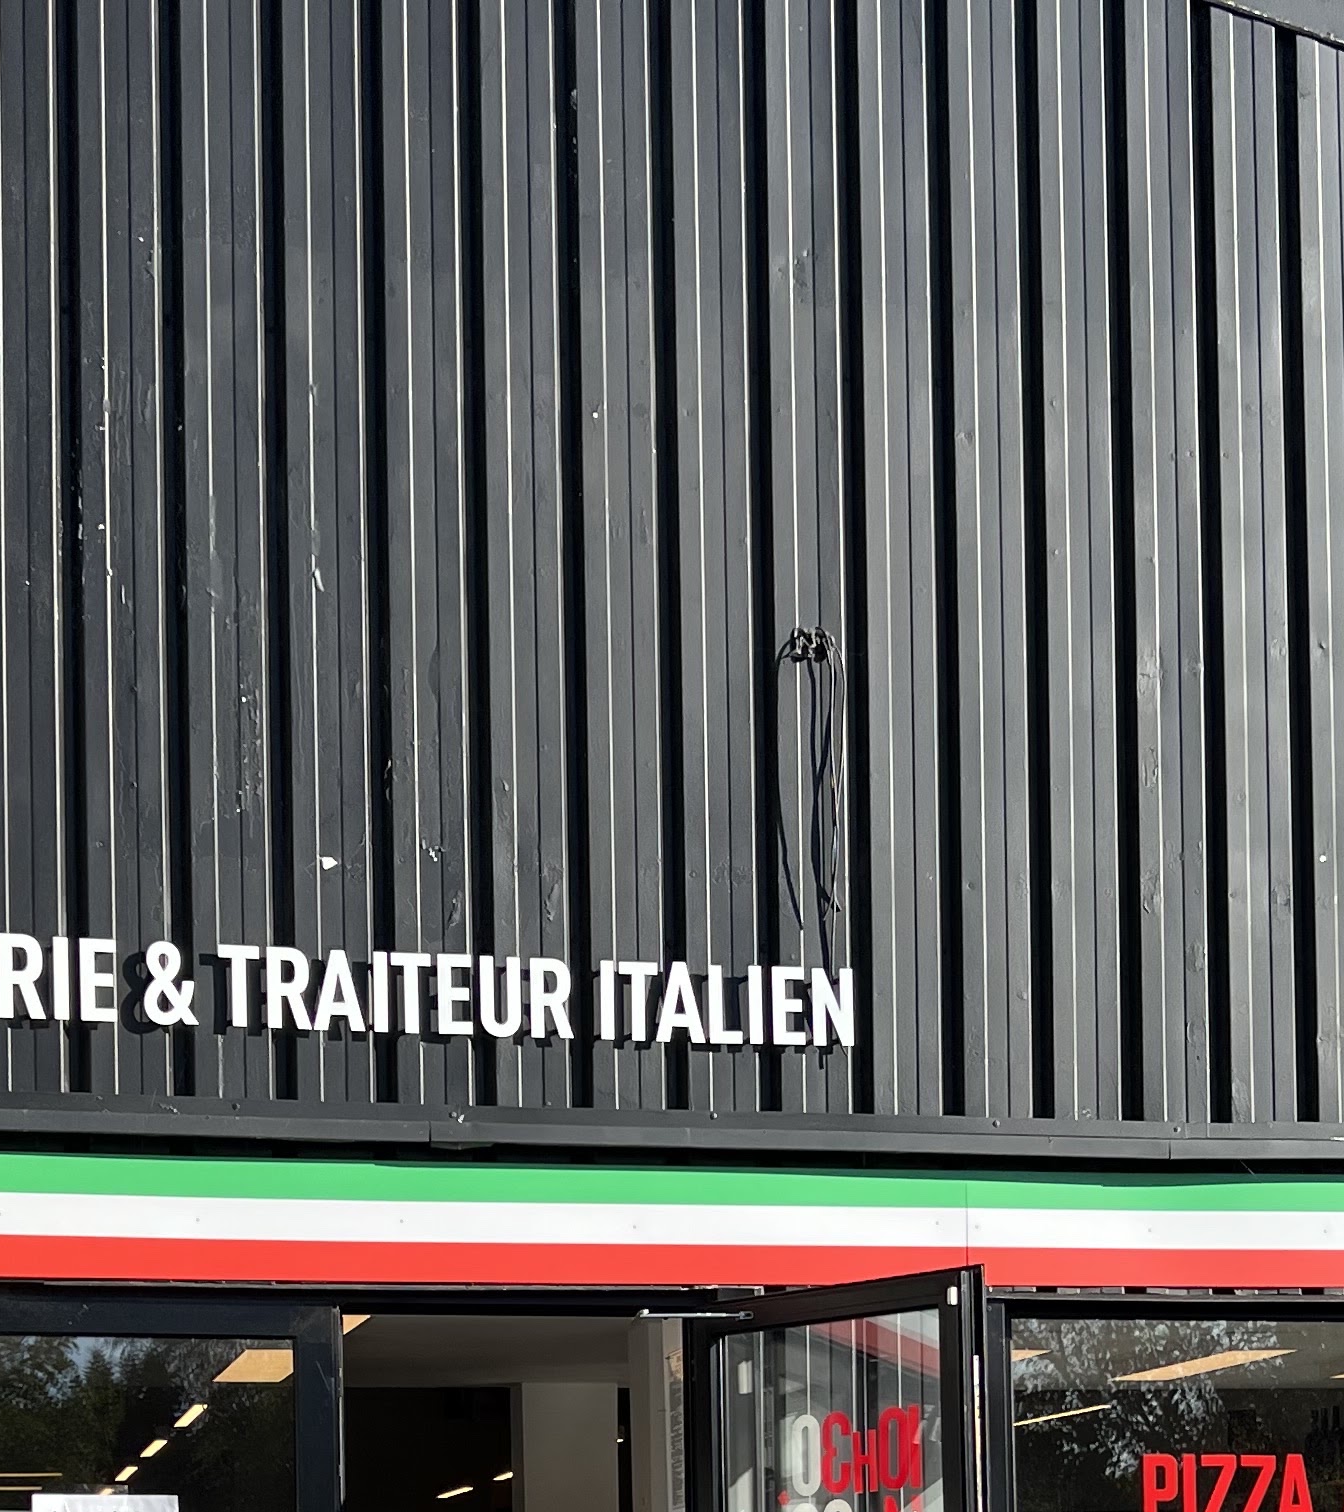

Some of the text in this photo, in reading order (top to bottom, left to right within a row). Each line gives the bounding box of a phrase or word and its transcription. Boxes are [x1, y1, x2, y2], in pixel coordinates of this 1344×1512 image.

[143, 940, 200, 1026] &
[218, 943, 576, 1040] TRAITEUR
[600, 959, 856, 1047] ITALIEN
